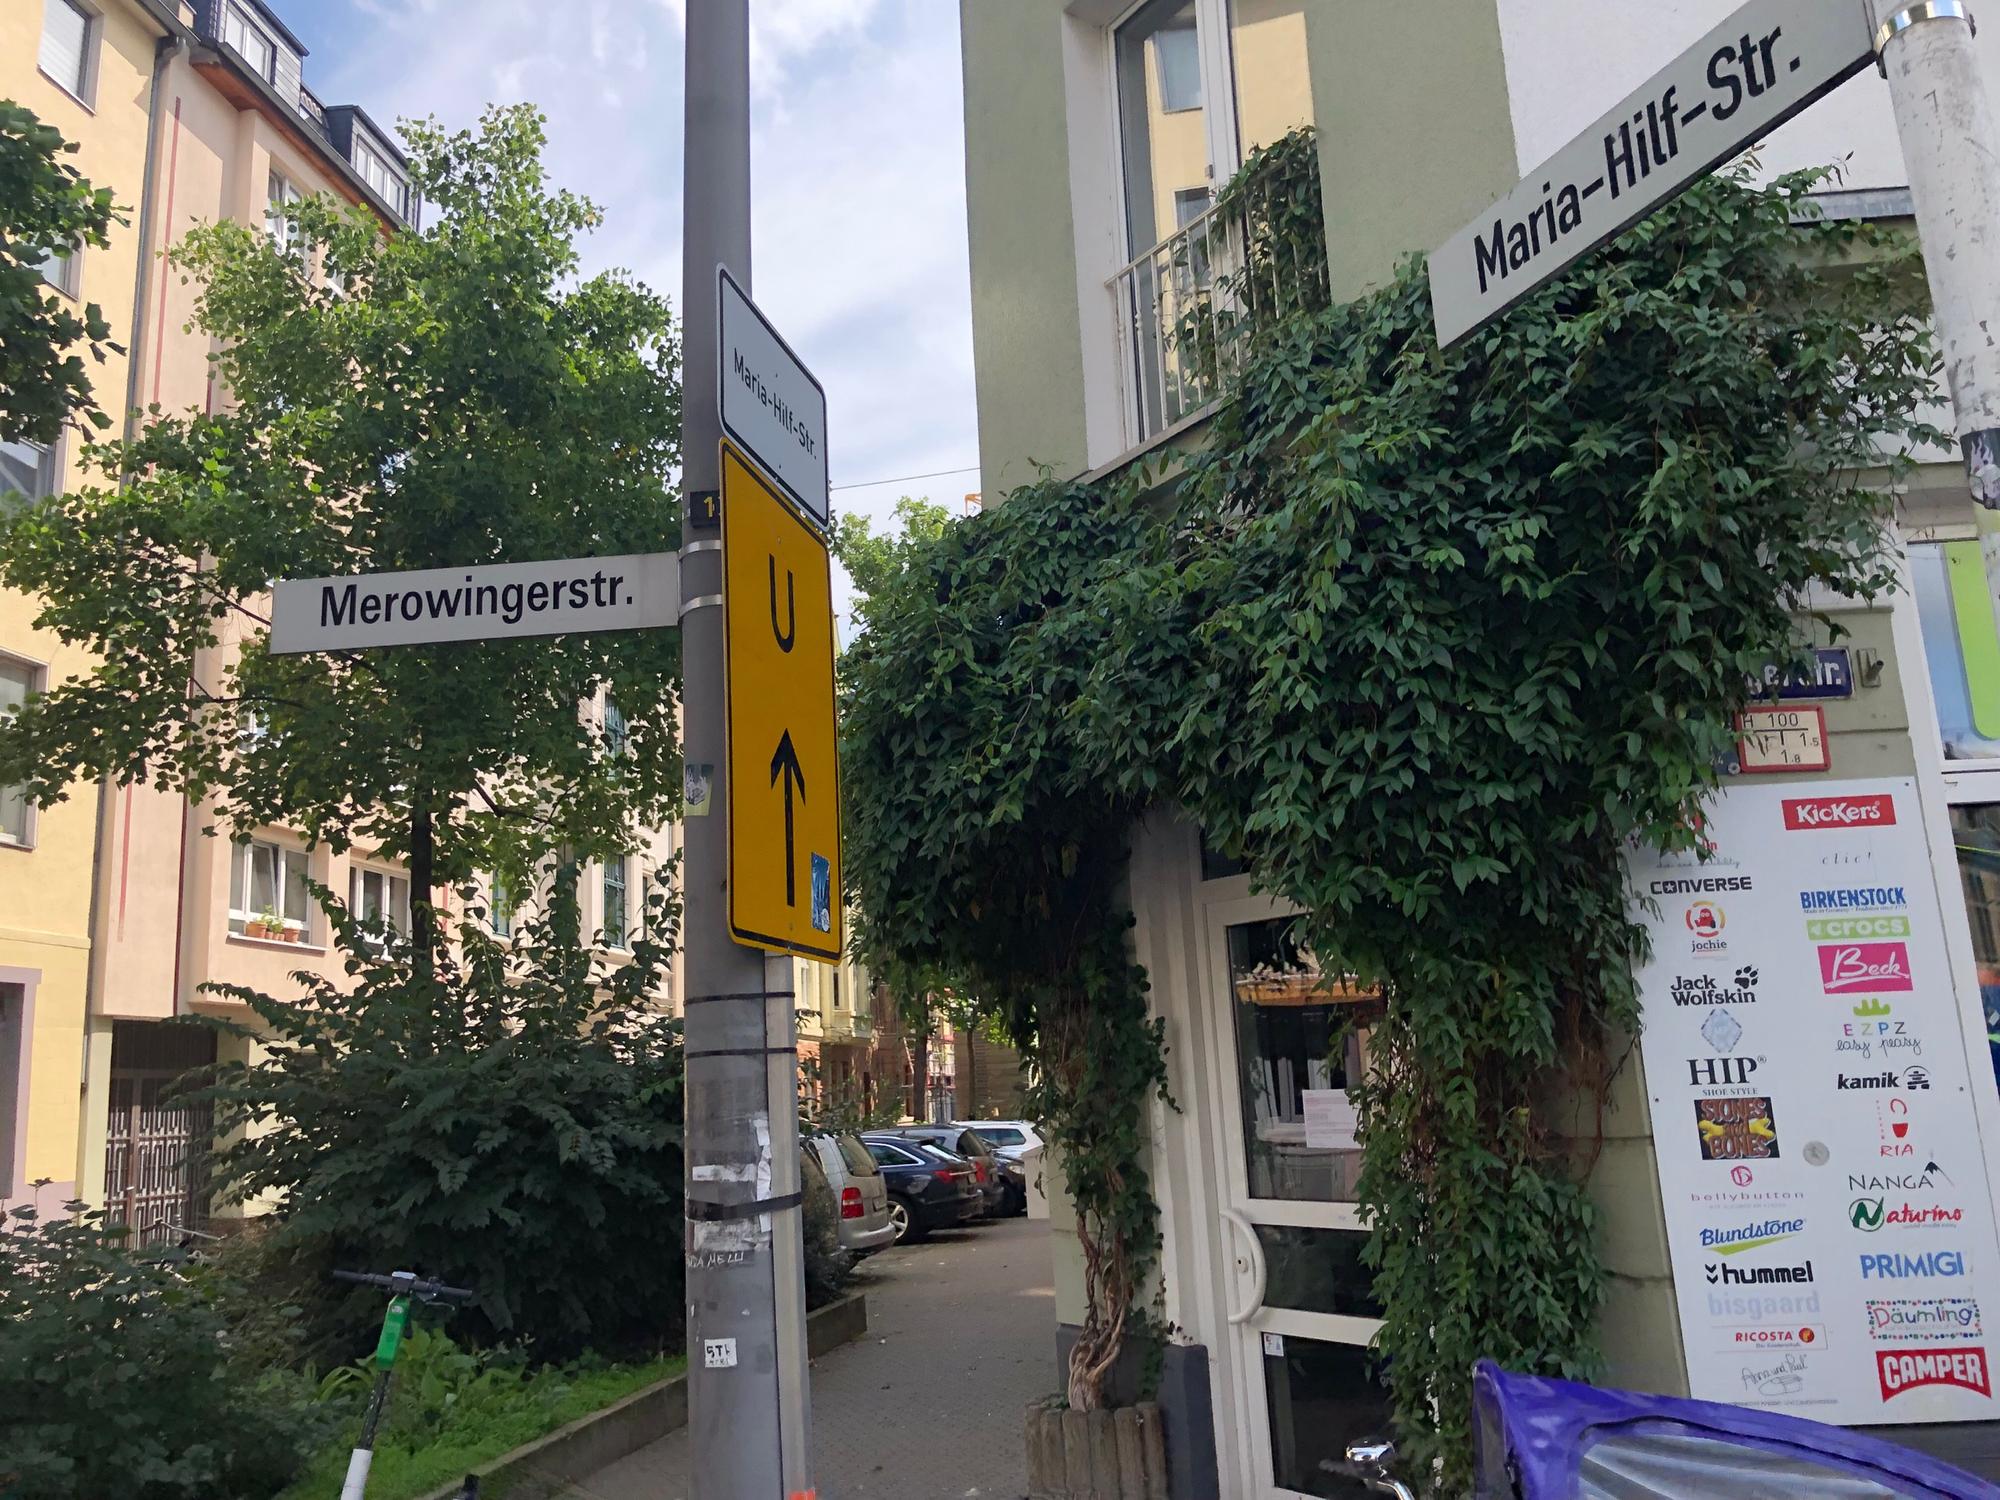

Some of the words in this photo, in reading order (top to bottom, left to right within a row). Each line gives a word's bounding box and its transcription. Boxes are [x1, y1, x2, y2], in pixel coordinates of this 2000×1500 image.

[1473, 26, 1801, 295] Maria-Hilf-Str.
[733, 347, 817, 460] Maria-Hilf-Str.
[320, 570, 634, 627] Merowingerstr.
[768, 553, 794, 654] U
[1768, 712, 1799, 728] 100
[1650, 876, 1753, 895] CONVERSE
[1800, 887, 1907, 909] BIRKENSTOCK
[1825, 919, 1905, 937] crocs
[1691, 940, 1728, 953] jochie
[1828, 947, 1911, 984] Beck
[1670, 974, 1717, 991] Jack
[1671, 988, 1757, 1006] Wolfskin
[1835, 1039, 1871, 1059] easy
[1879, 1037, 1923, 1058] peasy
[1702, 1087, 1728, 1096] SHOE
[1729, 1086, 1759, 1096] STYLE
[1837, 1071, 1900, 1090] kamik
[1880, 1144, 1914, 1157] RIA
[1849, 1174, 1935, 1190] NANGA
[1691, 1191, 1805, 1202] bellybutton
[1850, 1196, 1963, 1230] Naturino
[1699, 1218, 1805, 1247] Blundstone
[1721, 1260, 1815, 1285] hummel
[1860, 1251, 1965, 1279] PRIMIGI
[1707, 1290, 1821, 1321] bisgaard
[1872, 1305, 1974, 1328] Däumling
[1735, 1331, 1794, 1342] RICOSTA
[1883, 1353, 1985, 1389] CAMPER
